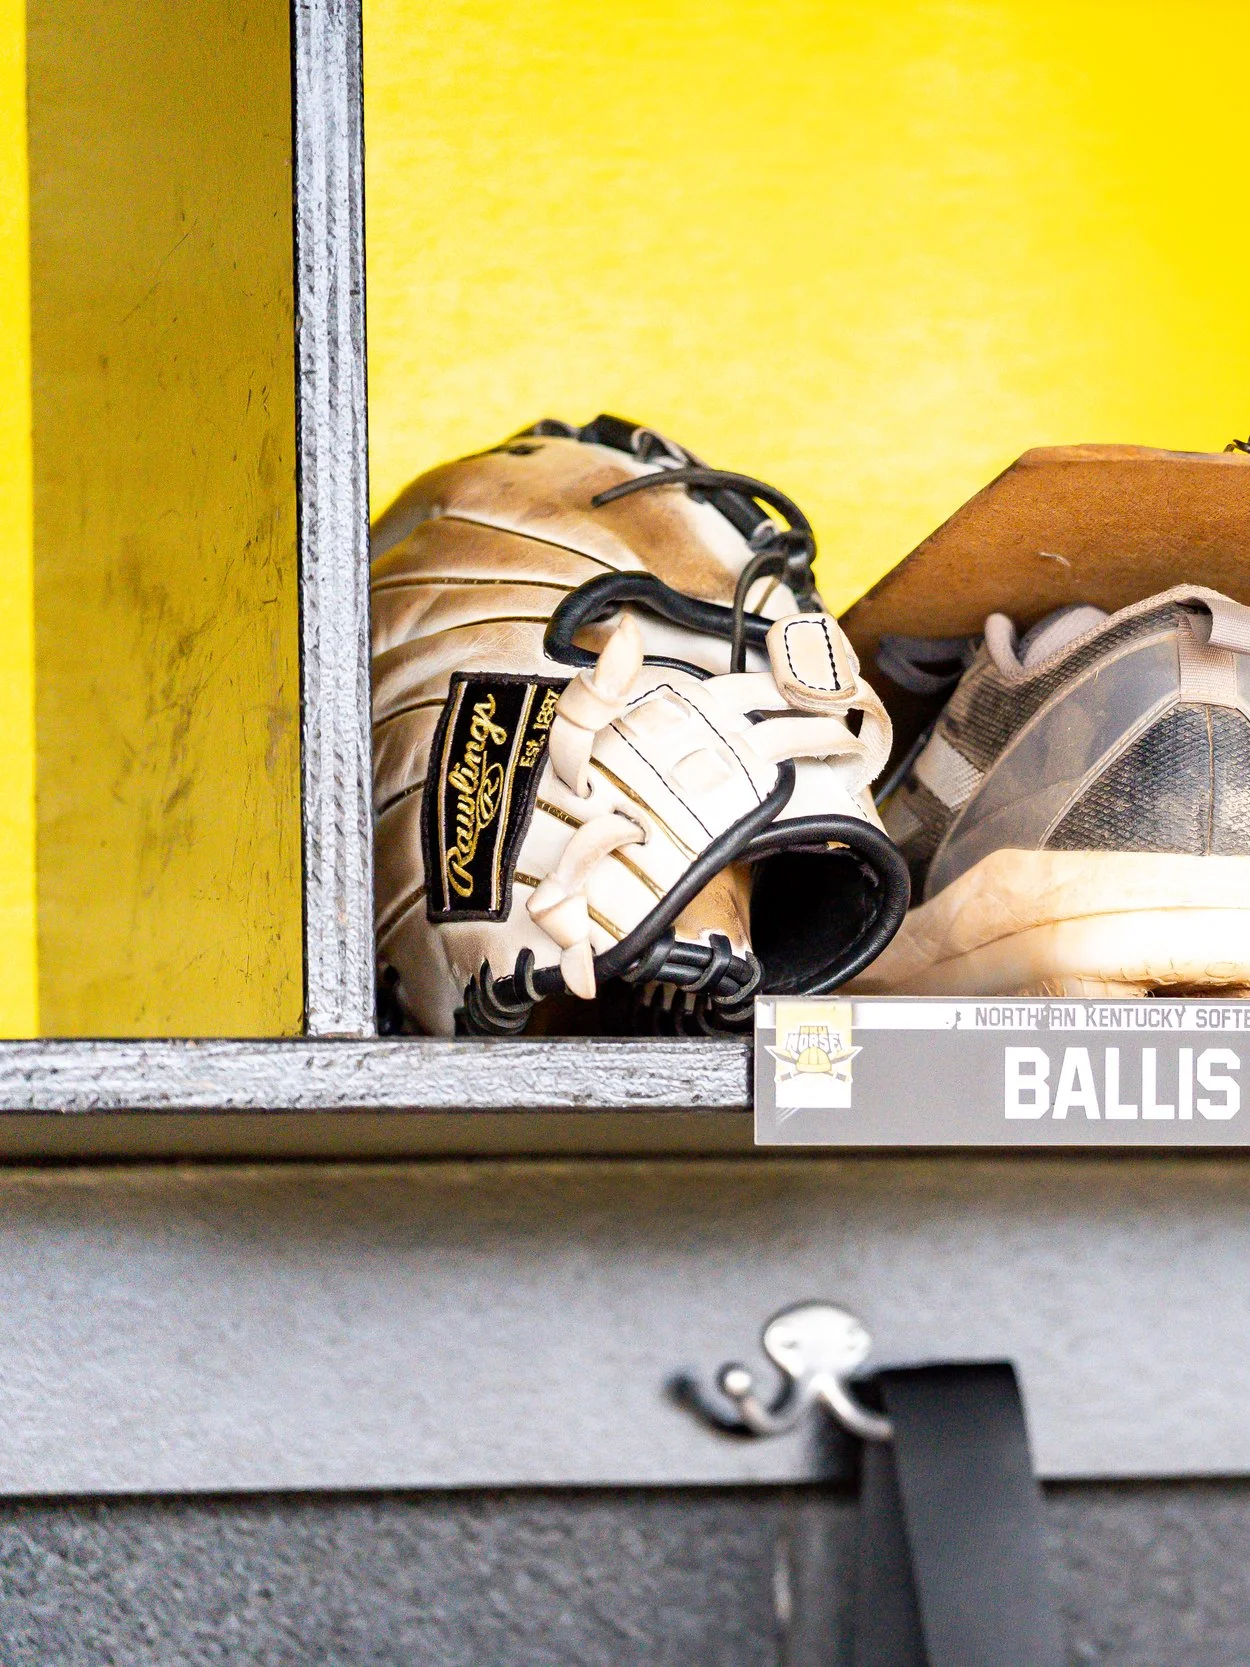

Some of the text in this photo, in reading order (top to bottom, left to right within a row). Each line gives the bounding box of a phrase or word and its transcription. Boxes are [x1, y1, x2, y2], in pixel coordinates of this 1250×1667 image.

[447, 693, 507, 898] Rawlings
[1084, 1006, 1187, 1028] KENTUCKY
[785, 1033, 843, 1055] NORSE
[1004, 1046, 1241, 1121] BALLIS
